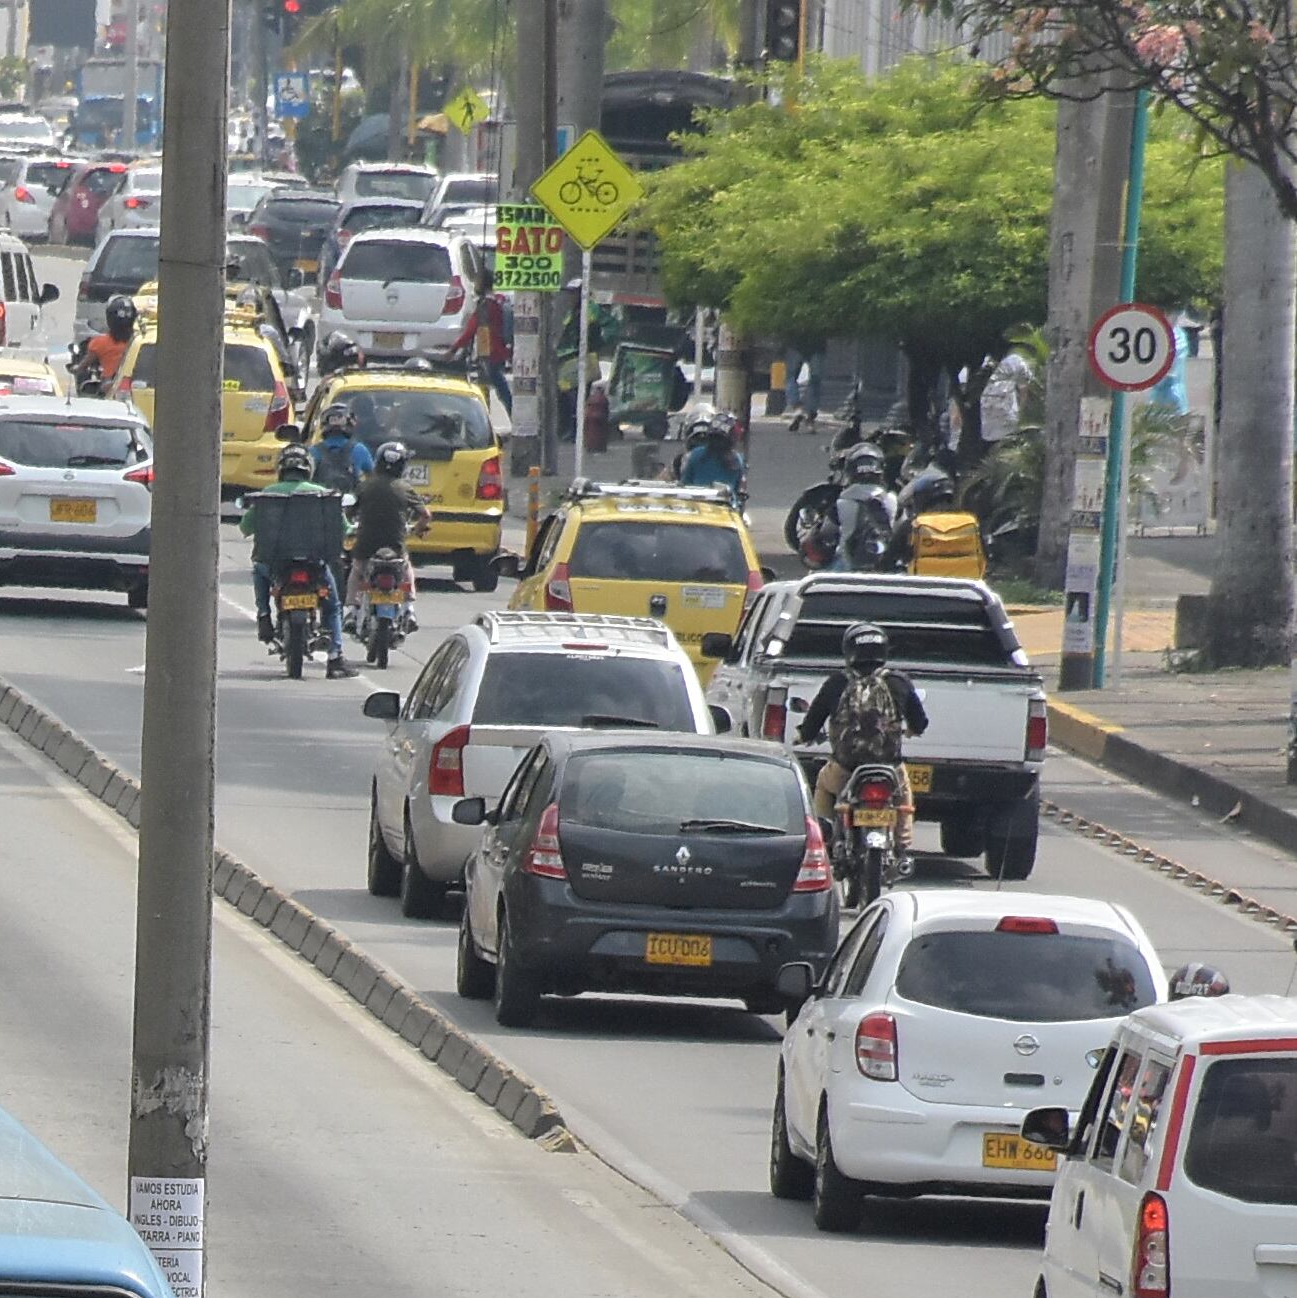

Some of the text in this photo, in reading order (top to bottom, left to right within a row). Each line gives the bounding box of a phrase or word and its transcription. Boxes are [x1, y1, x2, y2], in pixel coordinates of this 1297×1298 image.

[496, 226, 562, 255] GATO
[505, 256, 552, 270] 300
[1108, 327, 1156, 364] 30
[150, 1199, 182, 1211] AHORA
[169, 1215, 199, 1227] DIBUJO
[178, 1231, 200, 1242] PIANO
[167, 1272, 191, 1283] VOCAL
